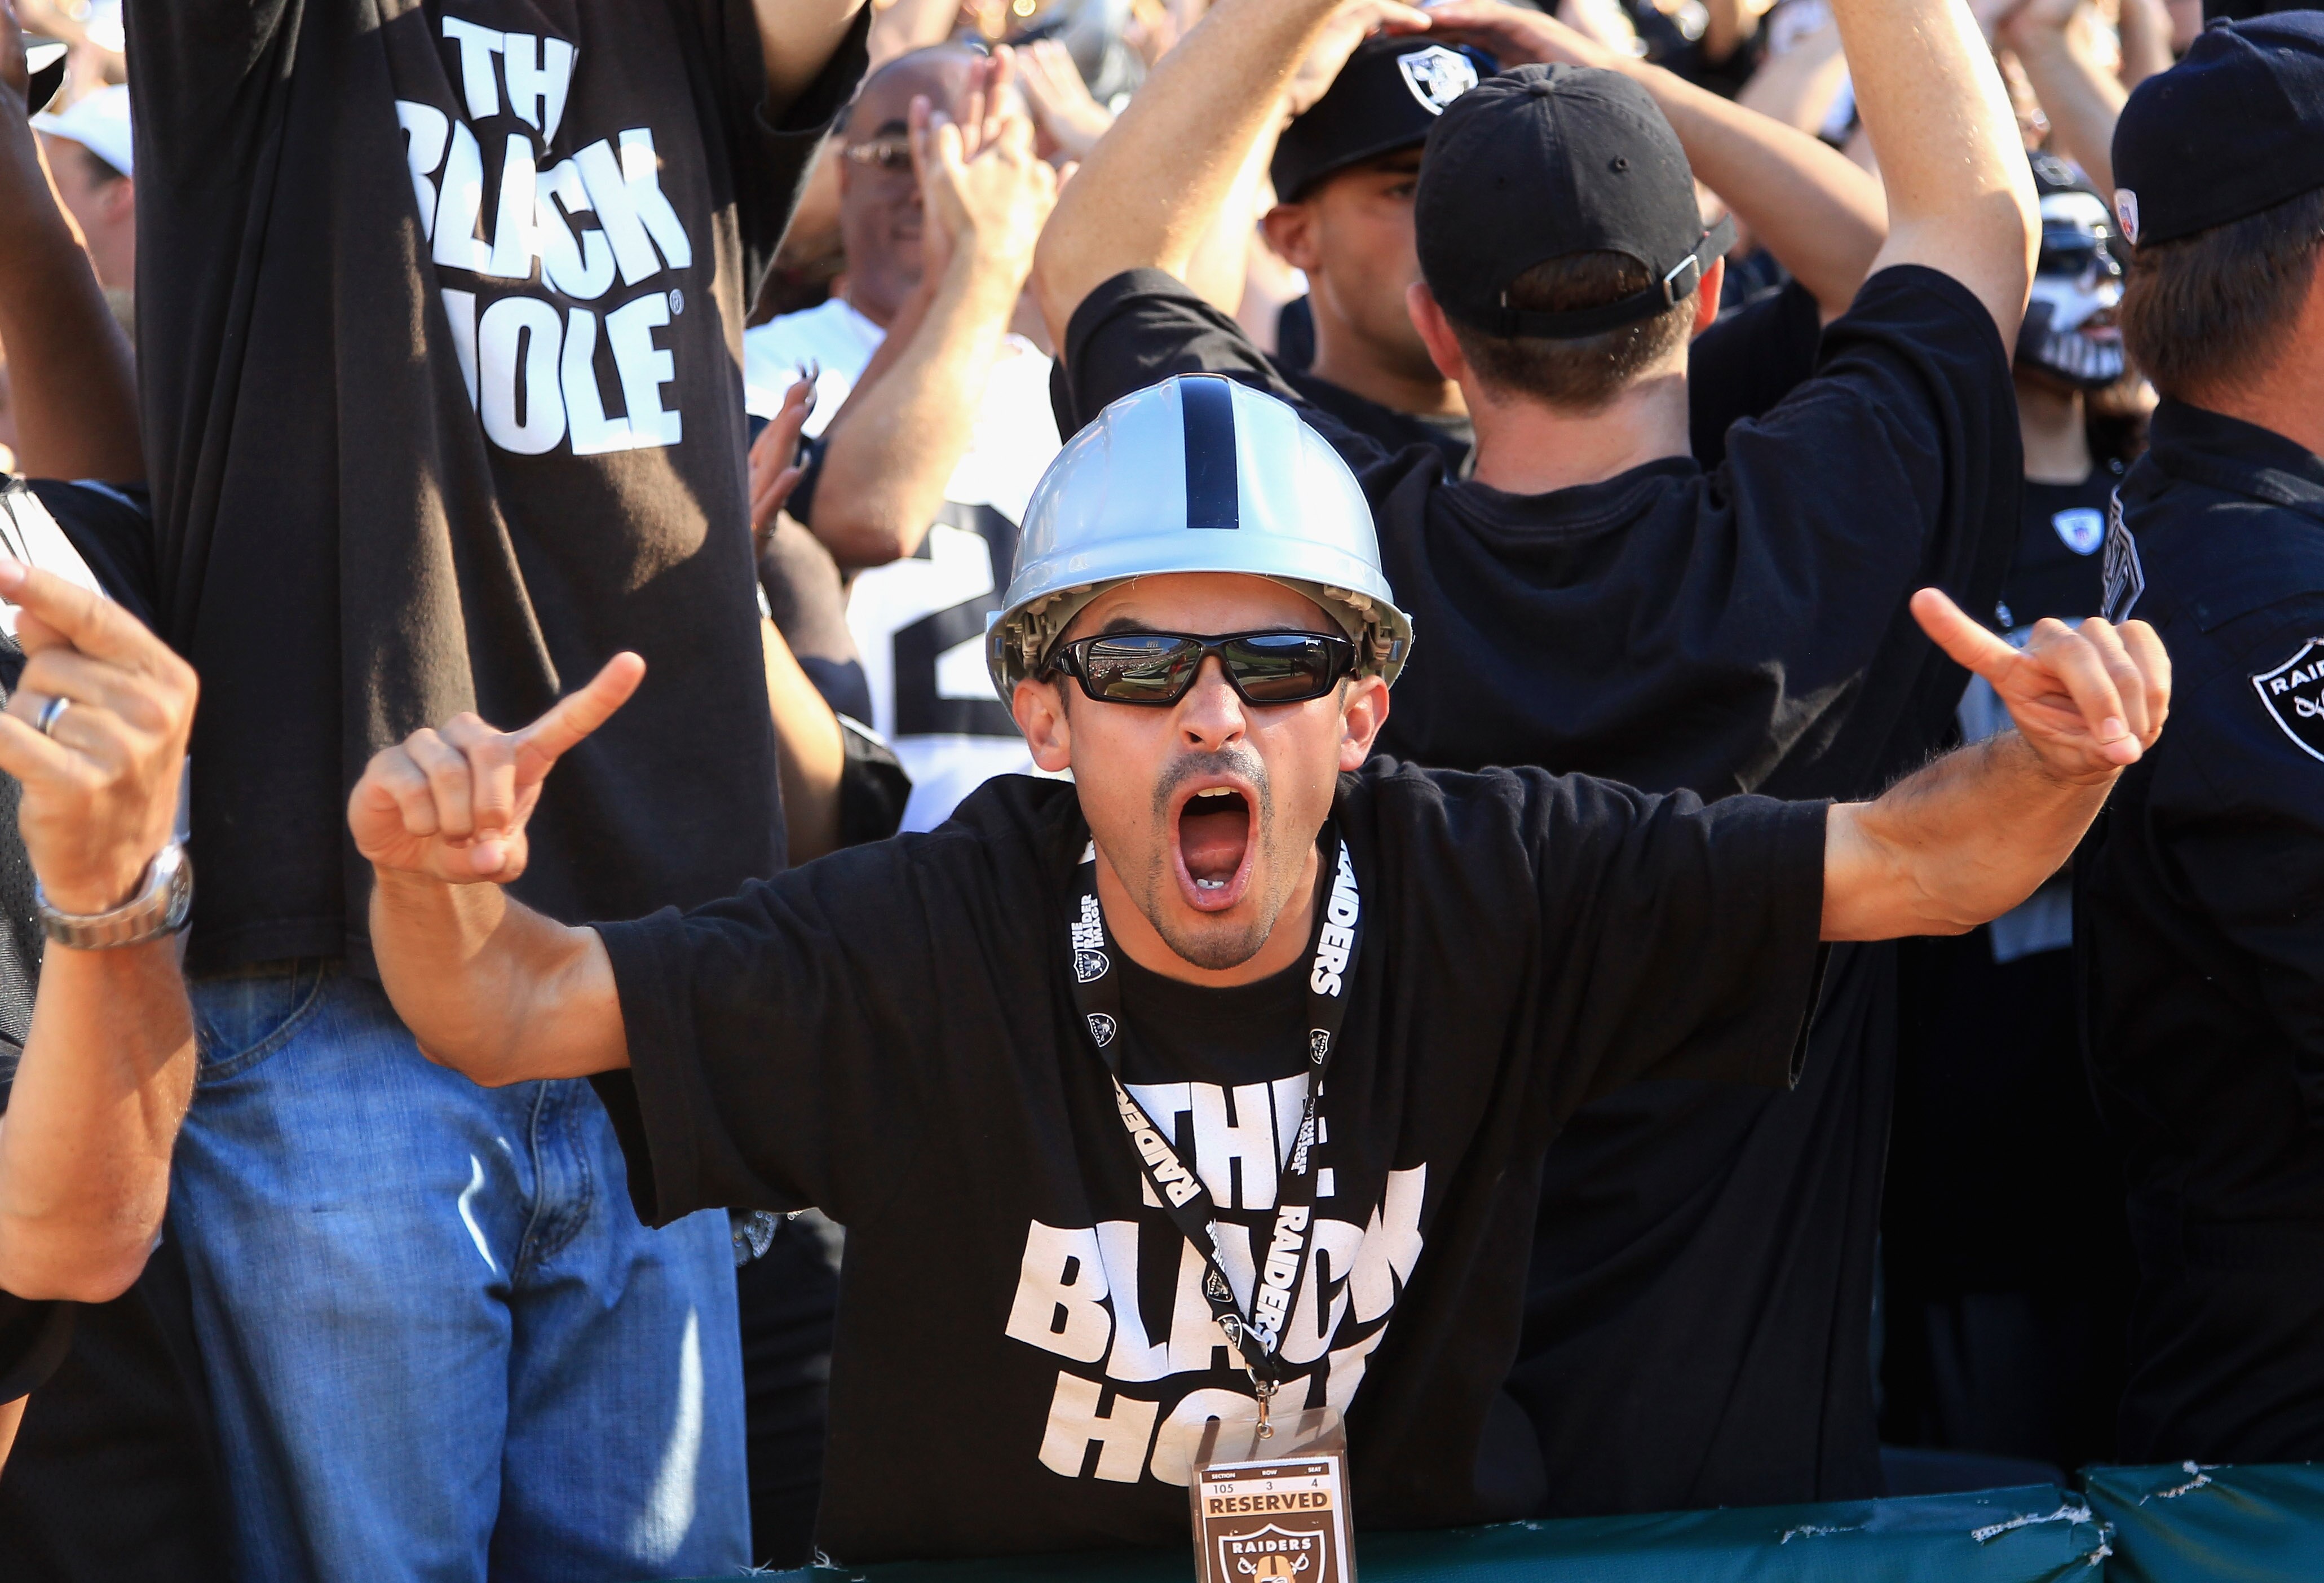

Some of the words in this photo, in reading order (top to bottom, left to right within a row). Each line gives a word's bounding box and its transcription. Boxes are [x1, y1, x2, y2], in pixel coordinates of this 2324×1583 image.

[442, 15, 580, 148] TH
[894, 500, 1024, 737] 2
[1071, 922, 1083, 949] THE
[1081, 894, 1095, 949] RAIDER
[1092, 898, 1105, 948] IMAGE
[1111, 1073, 1202, 1209] RAIDER
[1005, 1162, 1426, 1382] BLACK
[1209, 1492, 1328, 1514] RESERVED
[1213, 1484, 1234, 1494] 105
[1266, 1482, 1273, 1490] 3
[1311, 1478, 1318, 1488] 4
[1232, 1538, 1312, 1554] RAIDERS
